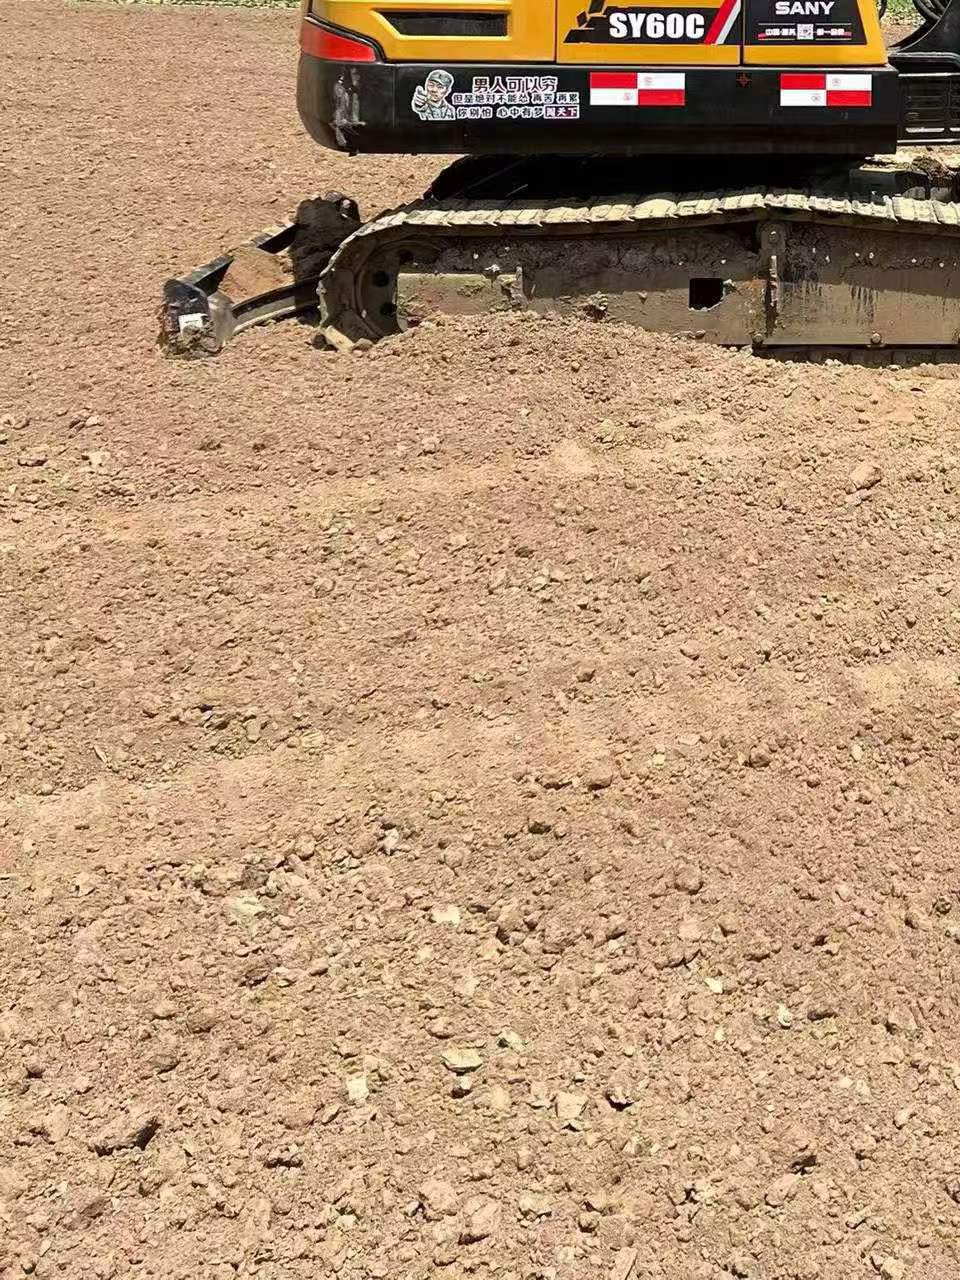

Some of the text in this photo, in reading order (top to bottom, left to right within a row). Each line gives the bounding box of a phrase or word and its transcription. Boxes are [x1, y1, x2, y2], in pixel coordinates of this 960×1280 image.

[775, 1, 835, 15] SANY
[609, 12, 705, 39] SY60C
[473, 76, 558, 93] 男人可以穷
[453, 93, 579, 105] 但是绝对不能怂 再苦 再累
[457, 106, 493, 118] 你别怕
